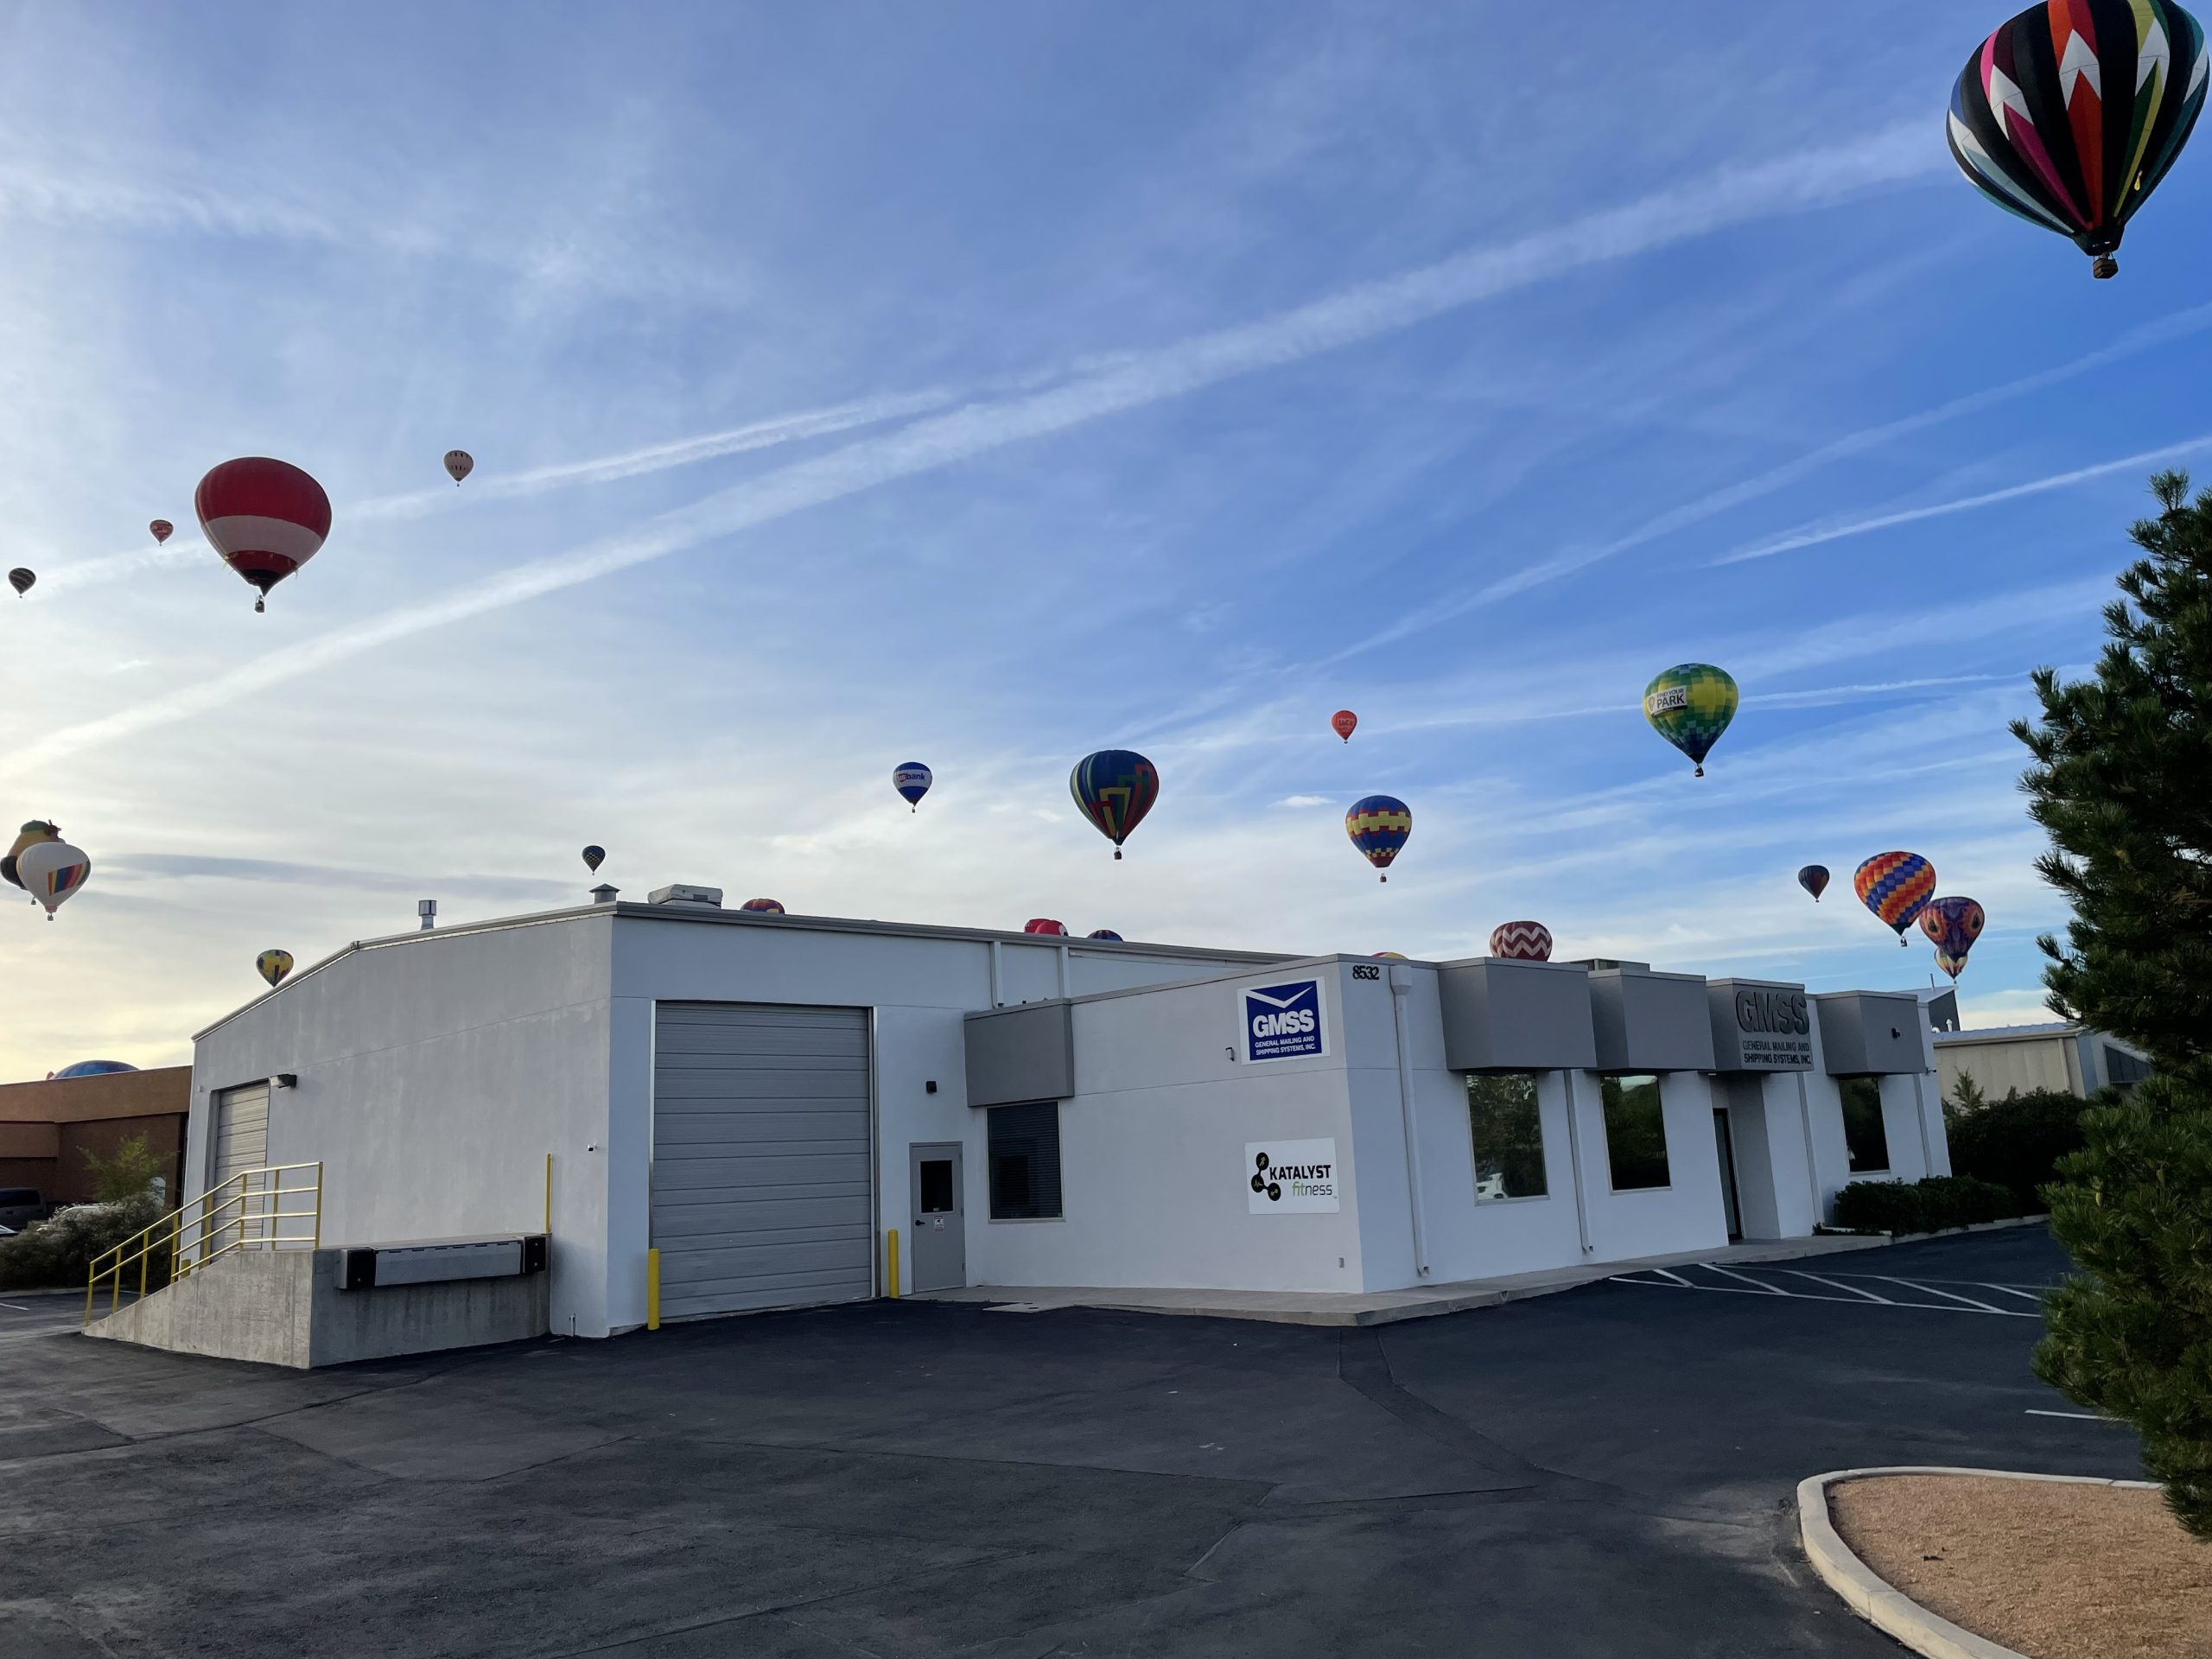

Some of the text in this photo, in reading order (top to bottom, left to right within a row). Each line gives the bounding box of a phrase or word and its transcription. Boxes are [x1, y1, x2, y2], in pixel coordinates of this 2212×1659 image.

[1656, 693, 1685, 709] PARK
[1352, 964, 1380, 980] 8532
[1736, 990, 1810, 1035] GMSS
[1252, 1009, 1315, 1038] GMSS
[1255, 1039, 1280, 1048] GENERAL
[1280, 1037, 1302, 1046] MAILING
[1255, 1046, 1280, 1055] SHIPPING
[1742, 1040, 1810, 1052] GENERAL MAILING AND
[1744, 1052, 1772, 1064] SHIPPING
[1269, 1164, 1332, 1180] KATALYST
[1292, 1180, 1332, 1196] fitness
